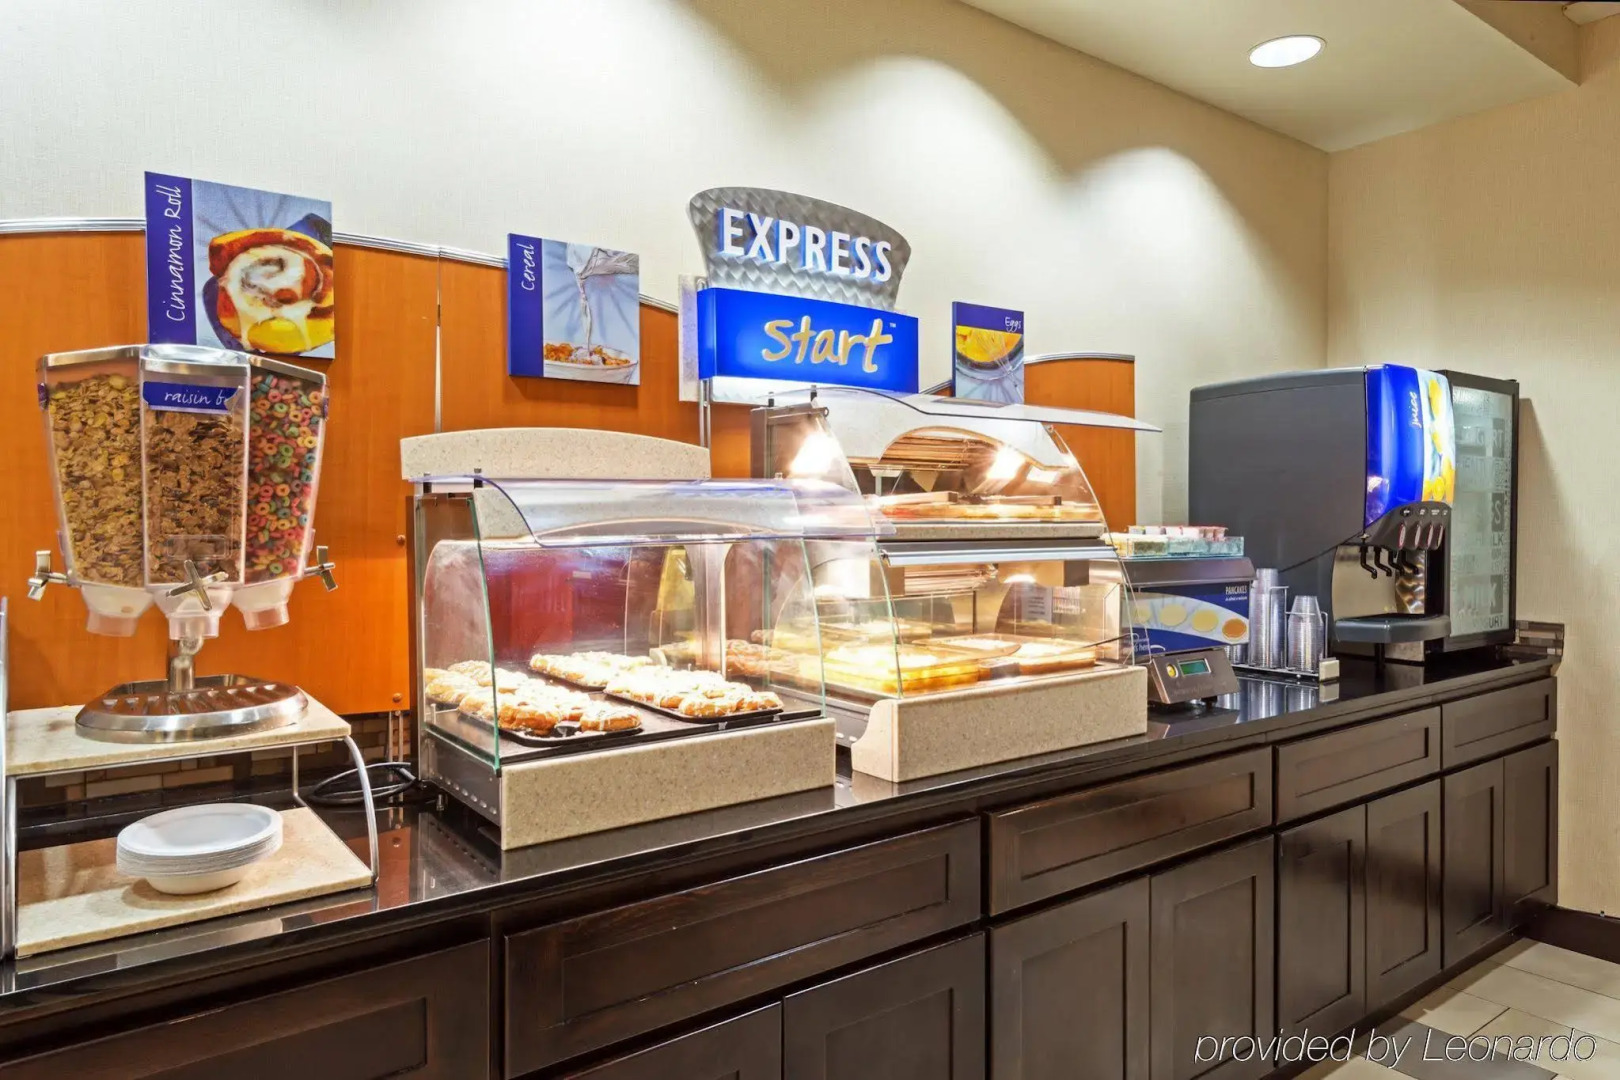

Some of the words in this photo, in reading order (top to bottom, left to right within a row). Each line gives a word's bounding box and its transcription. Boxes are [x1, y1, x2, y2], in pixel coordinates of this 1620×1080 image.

[155, 184, 182, 220] Roll
[719, 206, 892, 282] EXPRESS
[162, 224, 186, 322] Cinnamon
[516, 242, 536, 291] Cereal
[761, 315, 893, 373] Start
[1004, 316, 1022, 333] Eggs
[164, 389, 211, 405] raisin
[1408, 391, 1423, 429] juice
